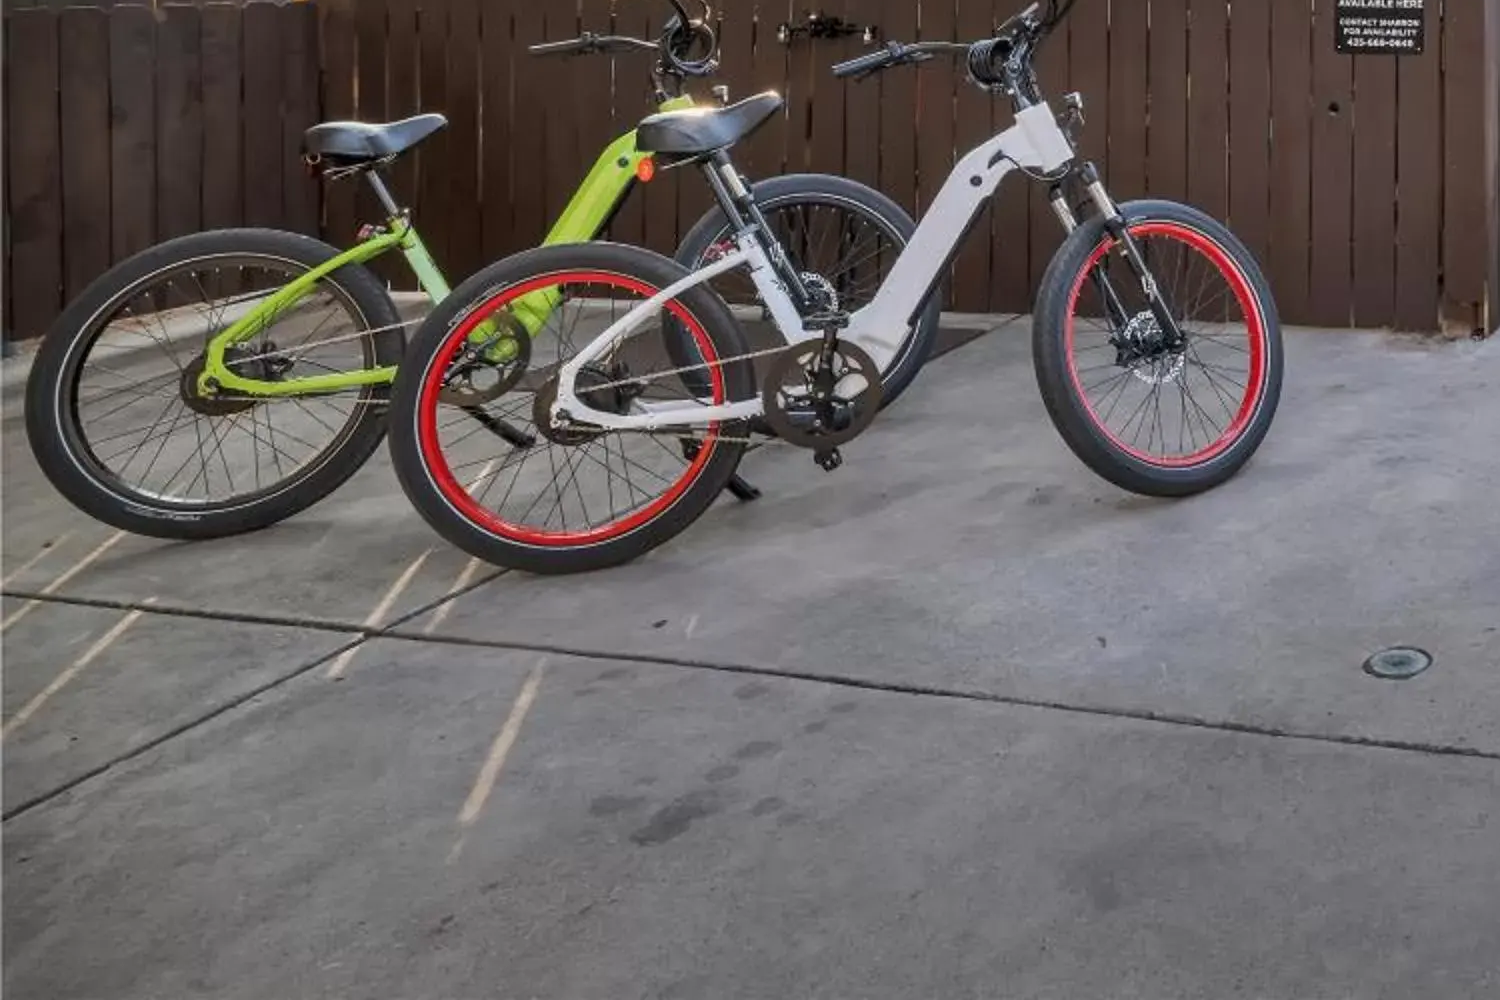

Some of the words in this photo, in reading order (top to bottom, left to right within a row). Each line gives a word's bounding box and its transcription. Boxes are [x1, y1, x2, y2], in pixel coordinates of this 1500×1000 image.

[1338, 0, 1395, 8] AVAILABLE
[1395, 0, 1424, 9] HERE
[1343, 27, 1361, 36] FOR
